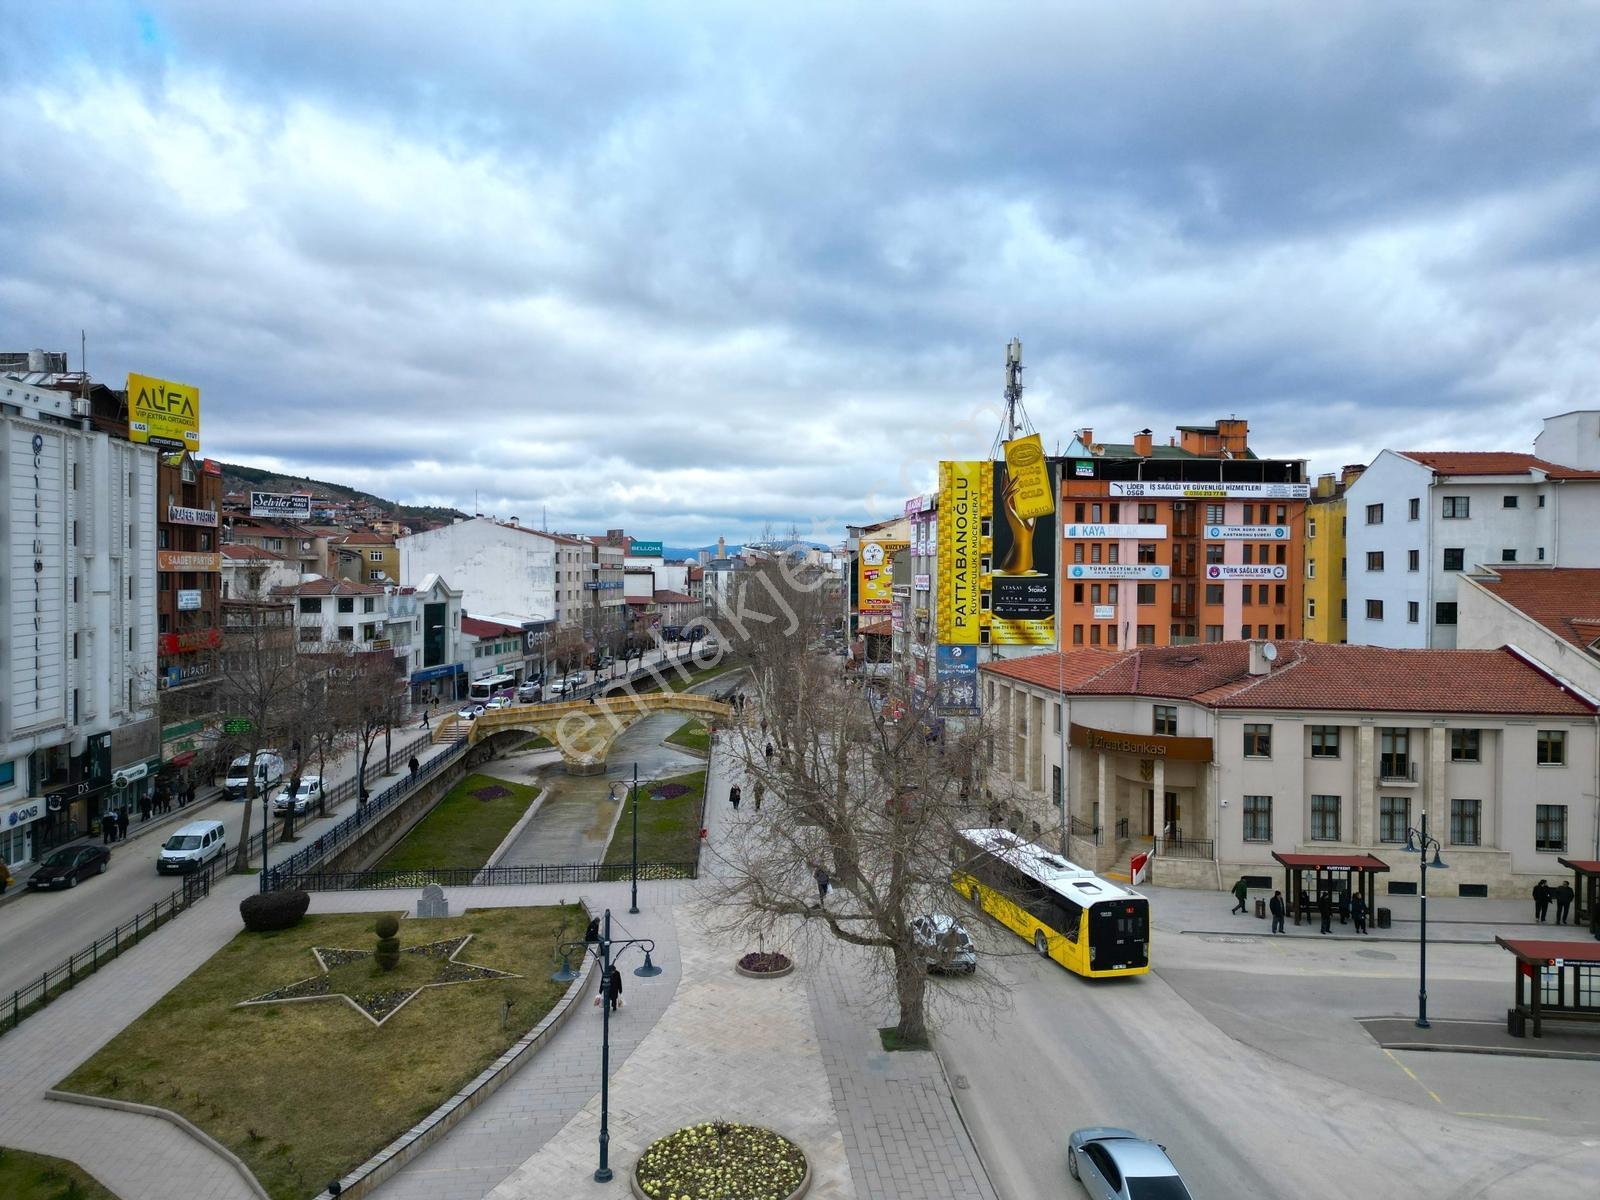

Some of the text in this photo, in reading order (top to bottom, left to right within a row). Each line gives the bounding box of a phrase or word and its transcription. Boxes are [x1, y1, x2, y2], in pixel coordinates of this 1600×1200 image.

[136, 386, 195, 418] ALFA
[147, 412, 167, 421] EXTRA
[134, 423, 146, 431] LGS
[1020, 488, 1045, 501] GOLD
[1225, 484, 1262, 492] HİZMETLERİ
[253, 494, 292, 507] Selviler
[970, 491, 979, 547] MÜCEVHERAT
[1082, 526, 1106, 537] KAYA
[952, 477, 968, 628] PATTABANOĞLU
[168, 555, 193, 565] SAADET
[1223, 566, 1239, 574] TÜRK
[1239, 566, 1259, 574] SAĞLIK
[970, 556, 978, 616] KUYUMCULUK
[1095, 735, 1167, 755] Ziraat Bankası
[18, 805, 38, 822] QNB
